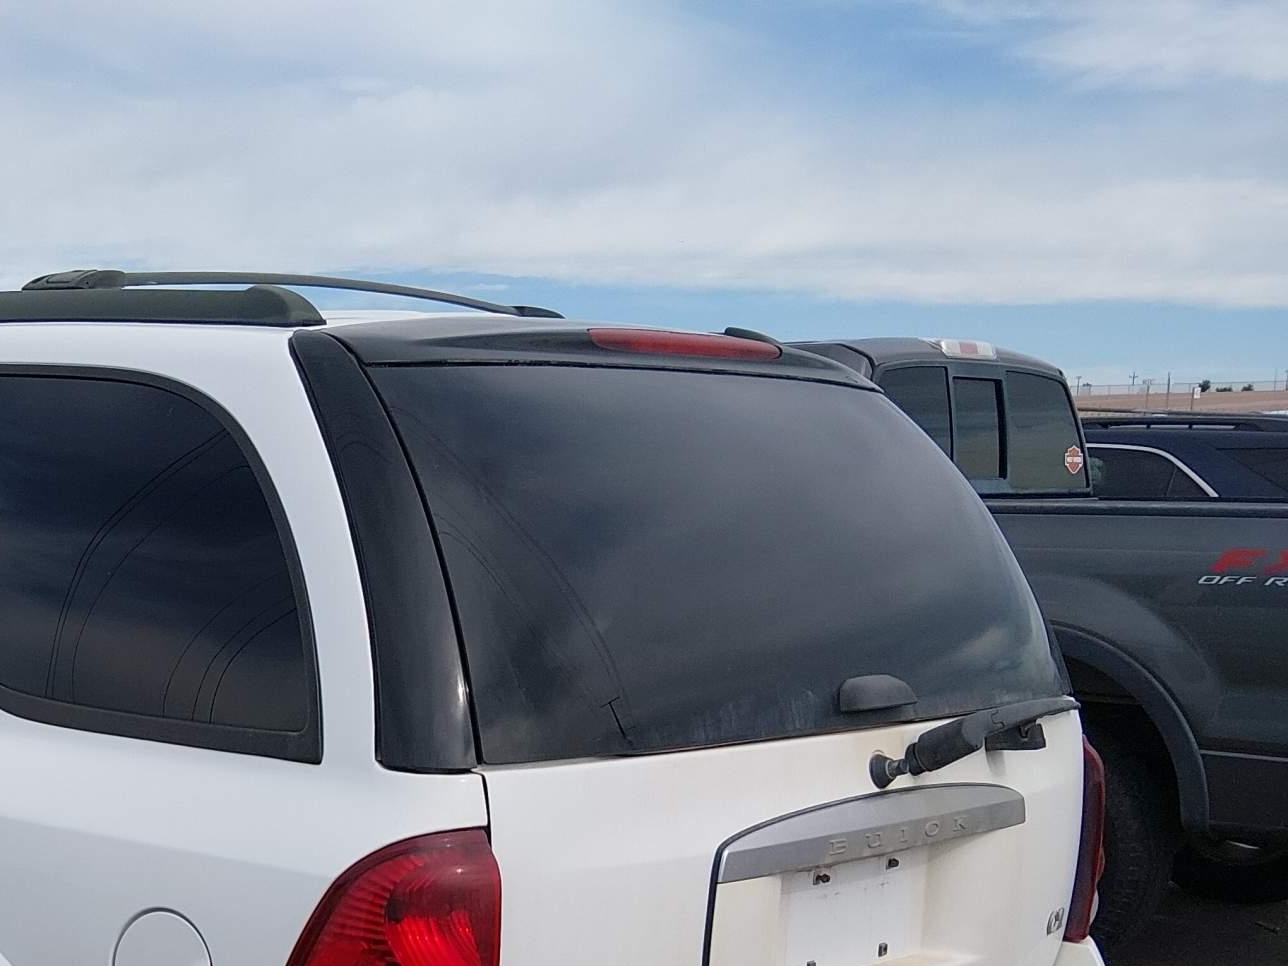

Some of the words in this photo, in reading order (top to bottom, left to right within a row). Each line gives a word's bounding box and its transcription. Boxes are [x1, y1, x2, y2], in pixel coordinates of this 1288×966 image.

[1197, 575, 1257, 585] OFF
[1263, 577, 1288, 586] R
[828, 815, 968, 856] BUICK
